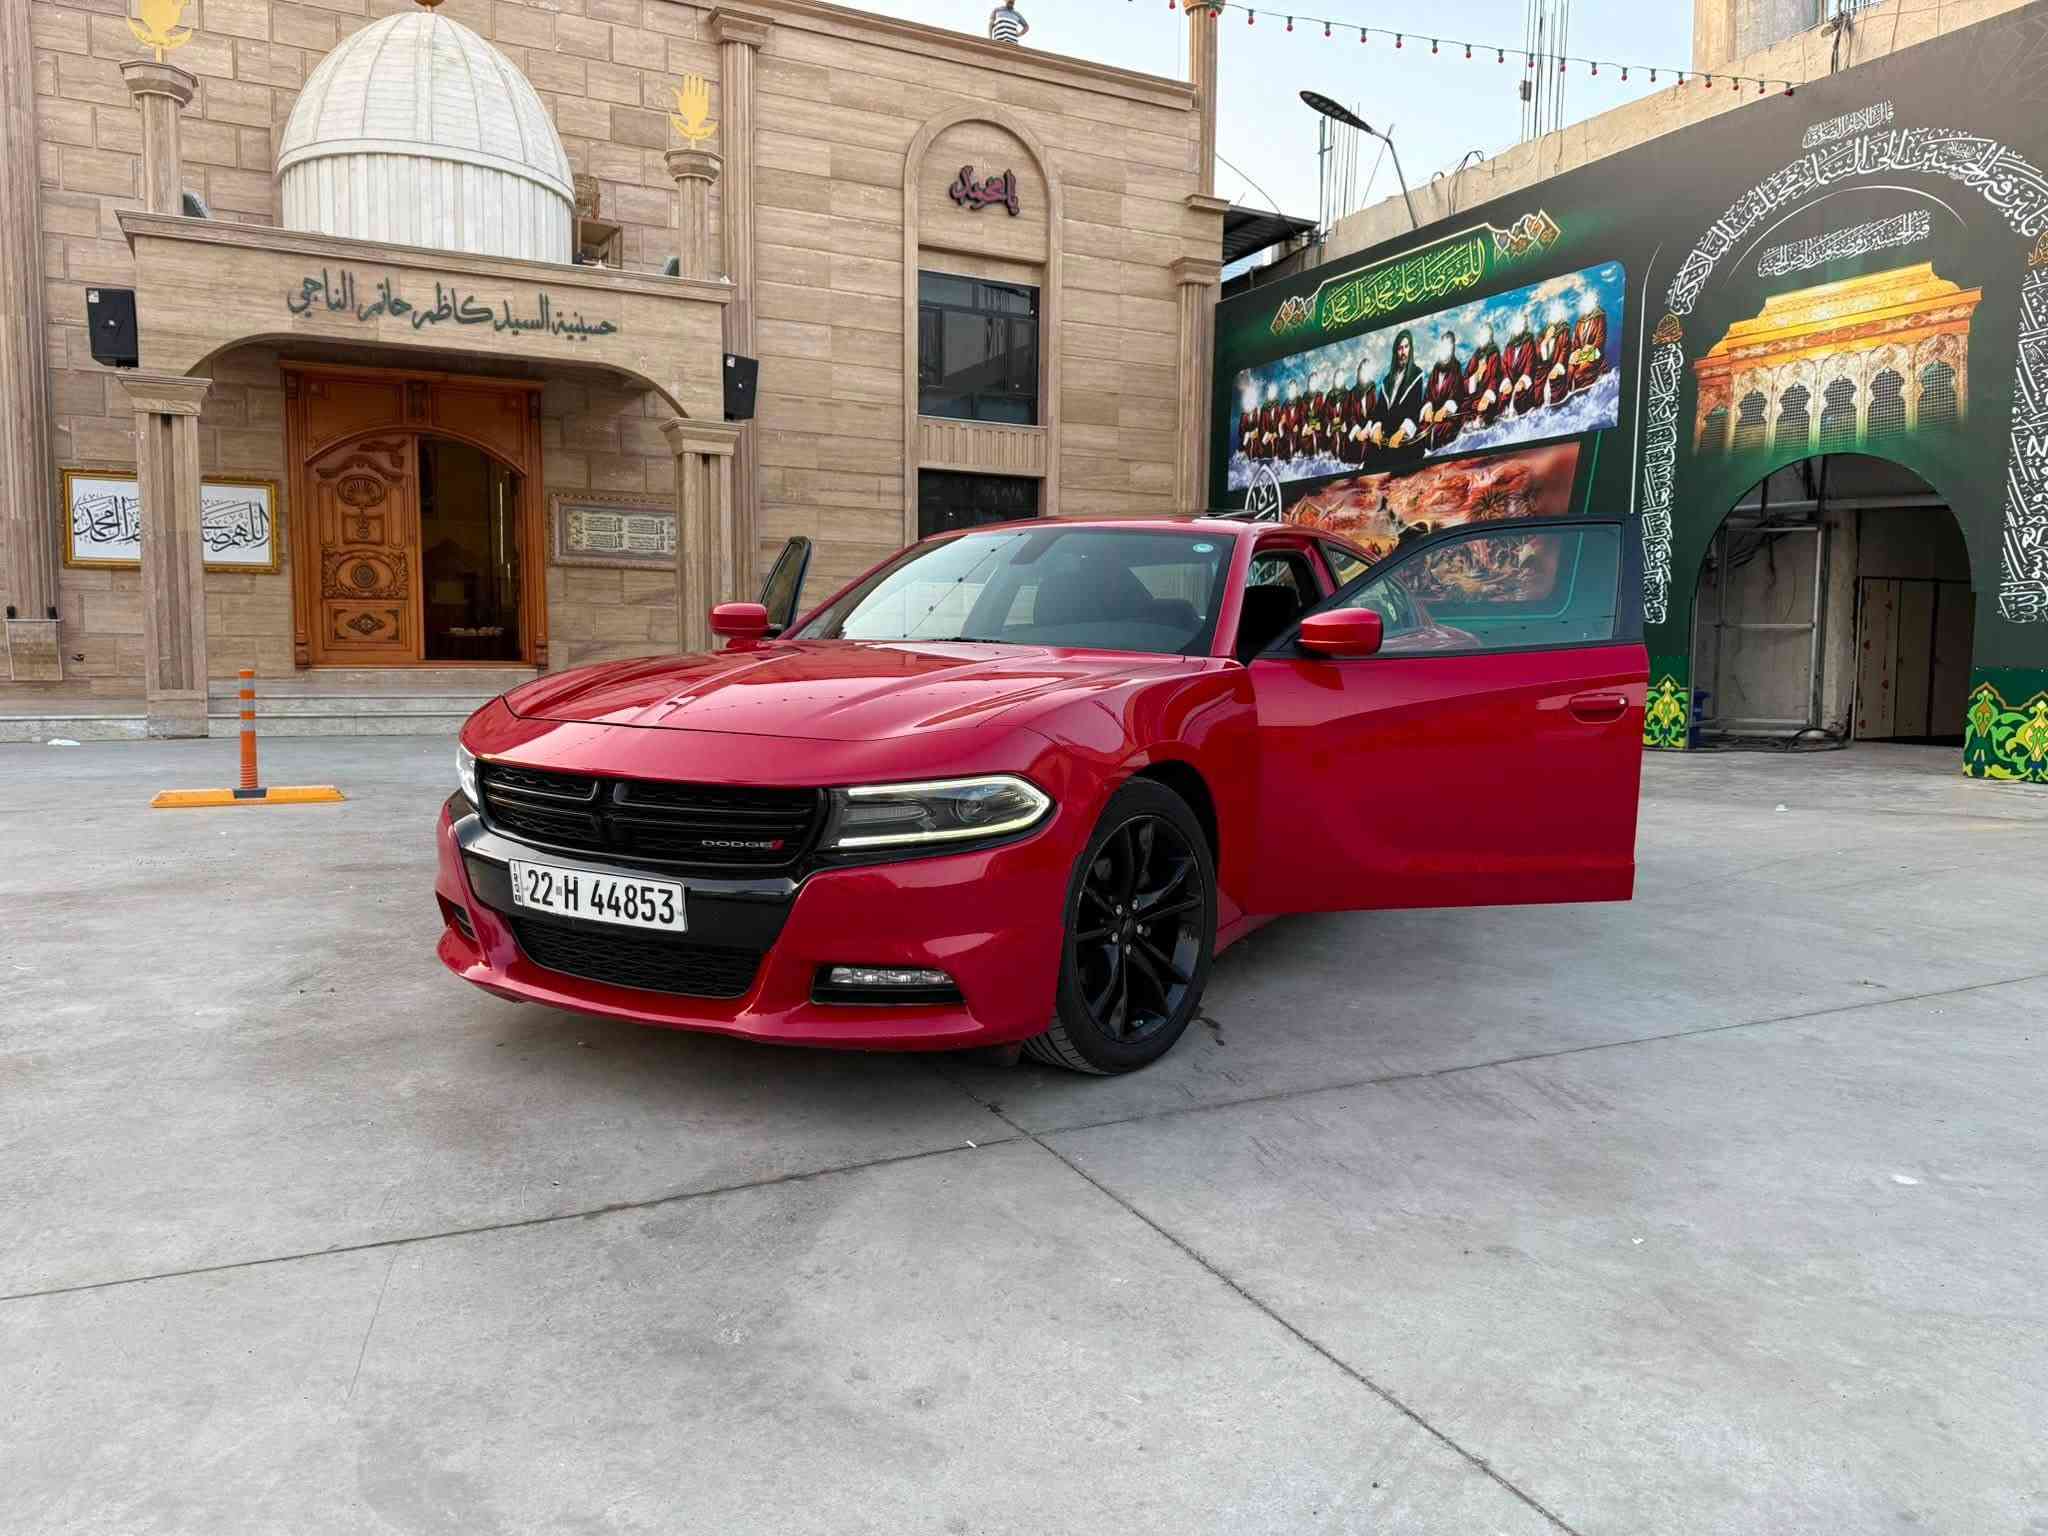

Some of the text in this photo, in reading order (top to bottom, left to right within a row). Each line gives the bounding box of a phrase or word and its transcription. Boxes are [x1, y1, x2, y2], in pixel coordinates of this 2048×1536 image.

[287, 267, 617, 342] حسينية السيد كاظم حاتم الناجي
[702, 839, 774, 849] DODGE
[527, 868, 675, 924] 22 H 44853
